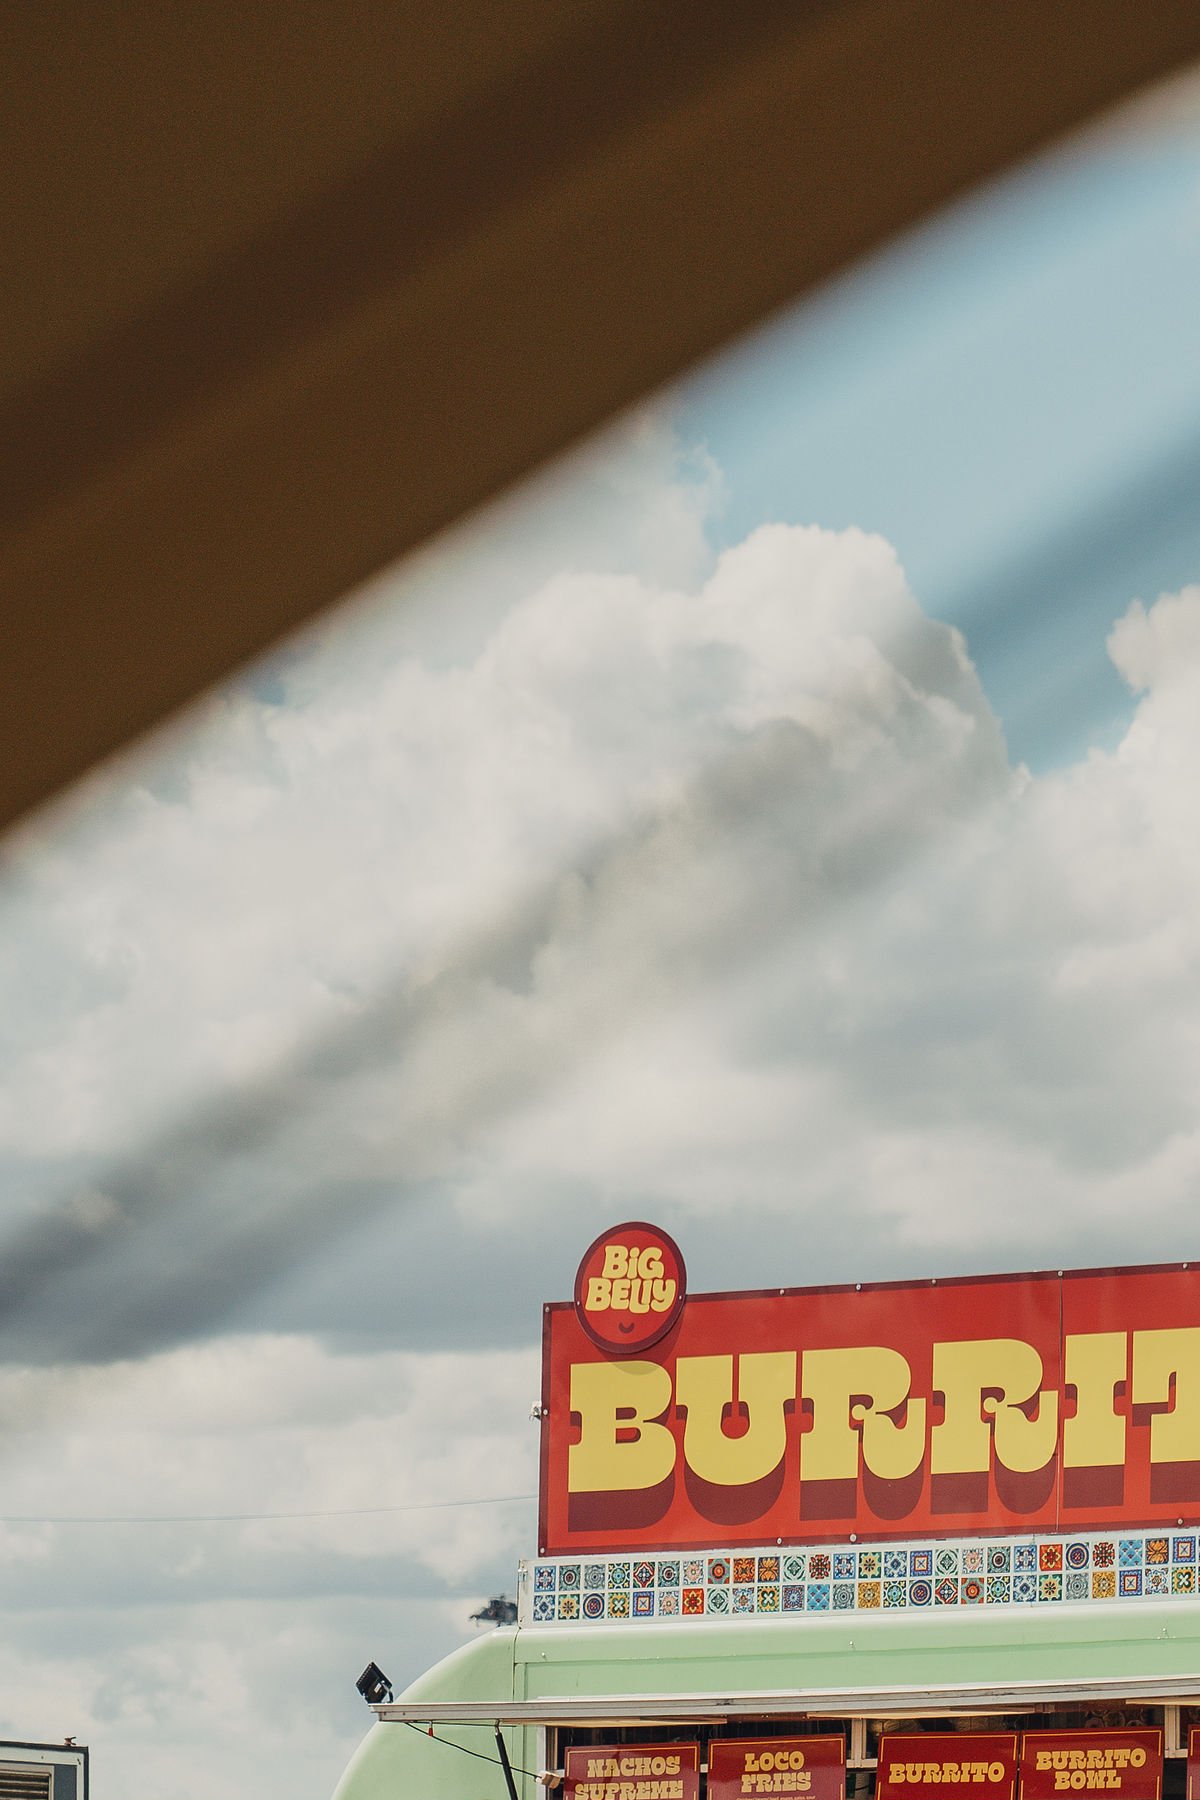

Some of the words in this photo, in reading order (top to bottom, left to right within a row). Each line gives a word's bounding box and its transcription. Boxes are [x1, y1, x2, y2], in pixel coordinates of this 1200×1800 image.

[587, 1755, 681, 1778] NACHOS
[745, 1750, 805, 1773] LOCO
[1036, 1748, 1147, 1771] BURRITO
[741, 1771, 812, 1794] FRIES
[888, 1762, 1005, 1784] BURRITO
[1054, 1769, 1122, 1790] BOWL
